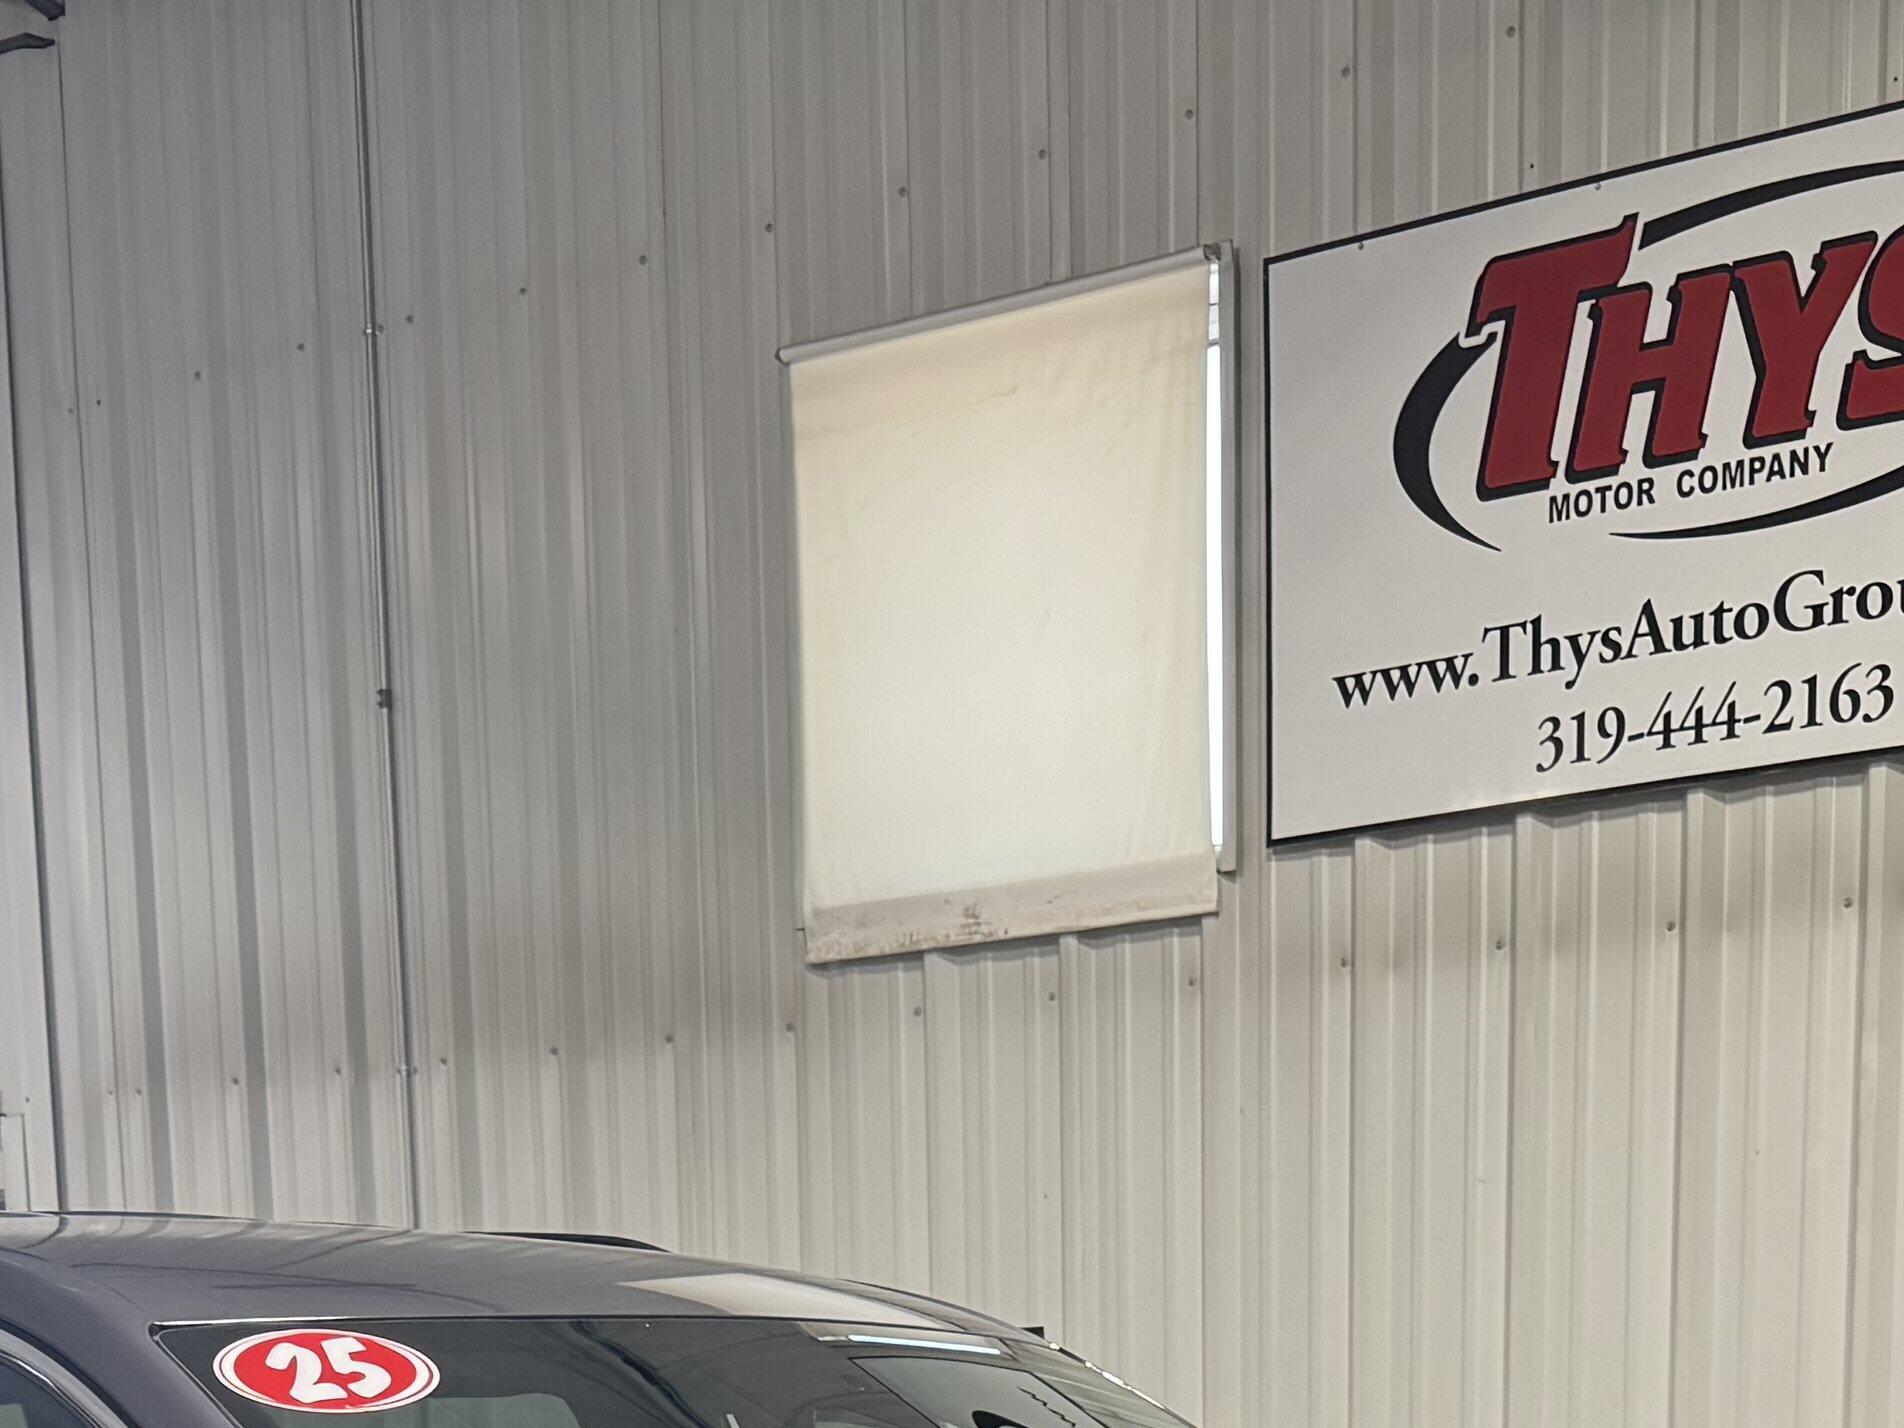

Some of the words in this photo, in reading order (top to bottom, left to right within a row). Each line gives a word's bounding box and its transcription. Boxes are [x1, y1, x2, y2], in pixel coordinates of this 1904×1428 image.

[1548, 475, 1656, 524] MOTOR
[1675, 441, 1834, 499] COMPANY
[1536, 662, 1895, 773] 319-444-2163
[264, 1336, 393, 1404] 25
